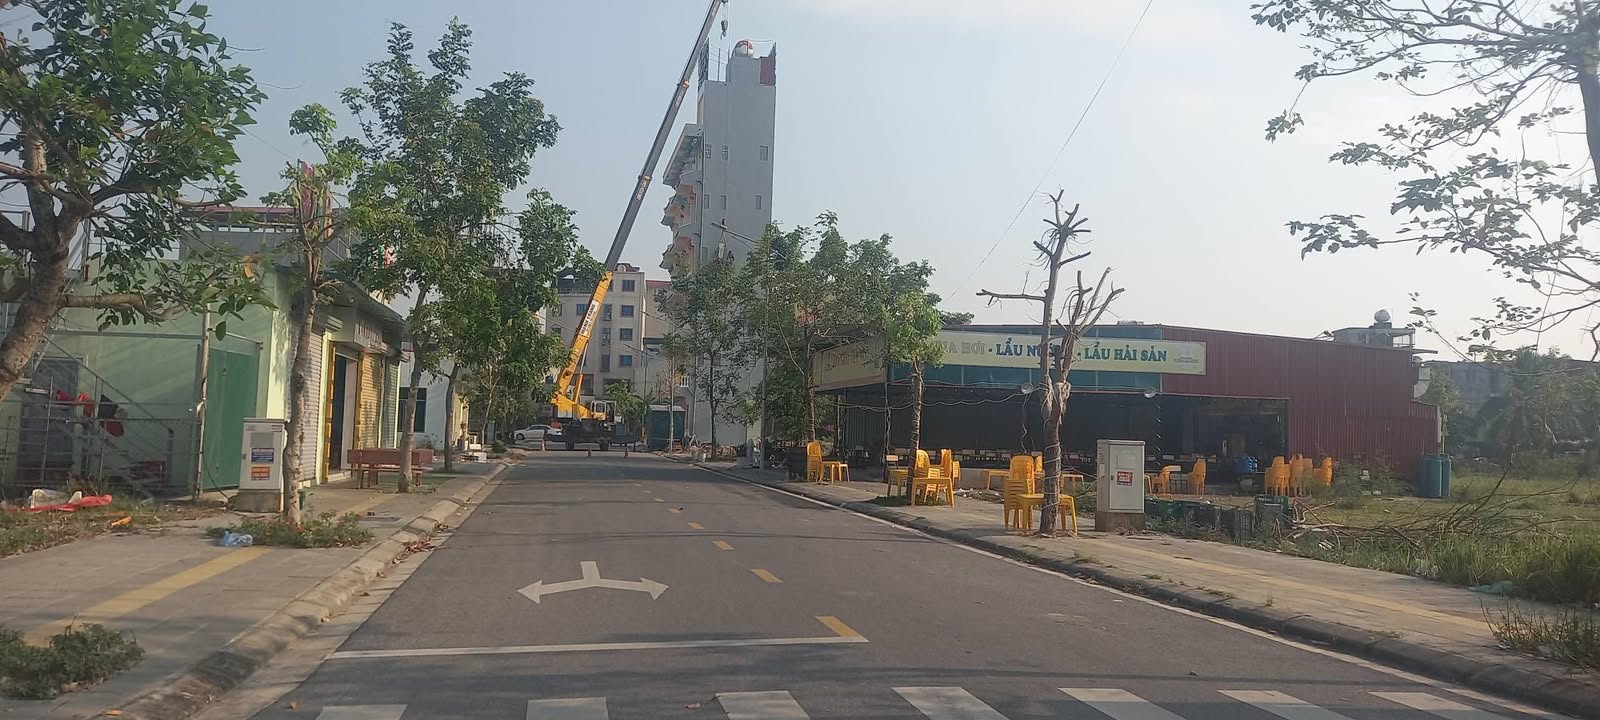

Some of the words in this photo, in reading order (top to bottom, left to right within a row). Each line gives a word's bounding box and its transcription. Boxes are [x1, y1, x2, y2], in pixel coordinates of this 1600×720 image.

[996, 337, 1023, 356] LẨU
[1084, 341, 1110, 360] LẨU
[1114, 344, 1138, 361] HẢI
[1140, 345, 1168, 362] SẢN
